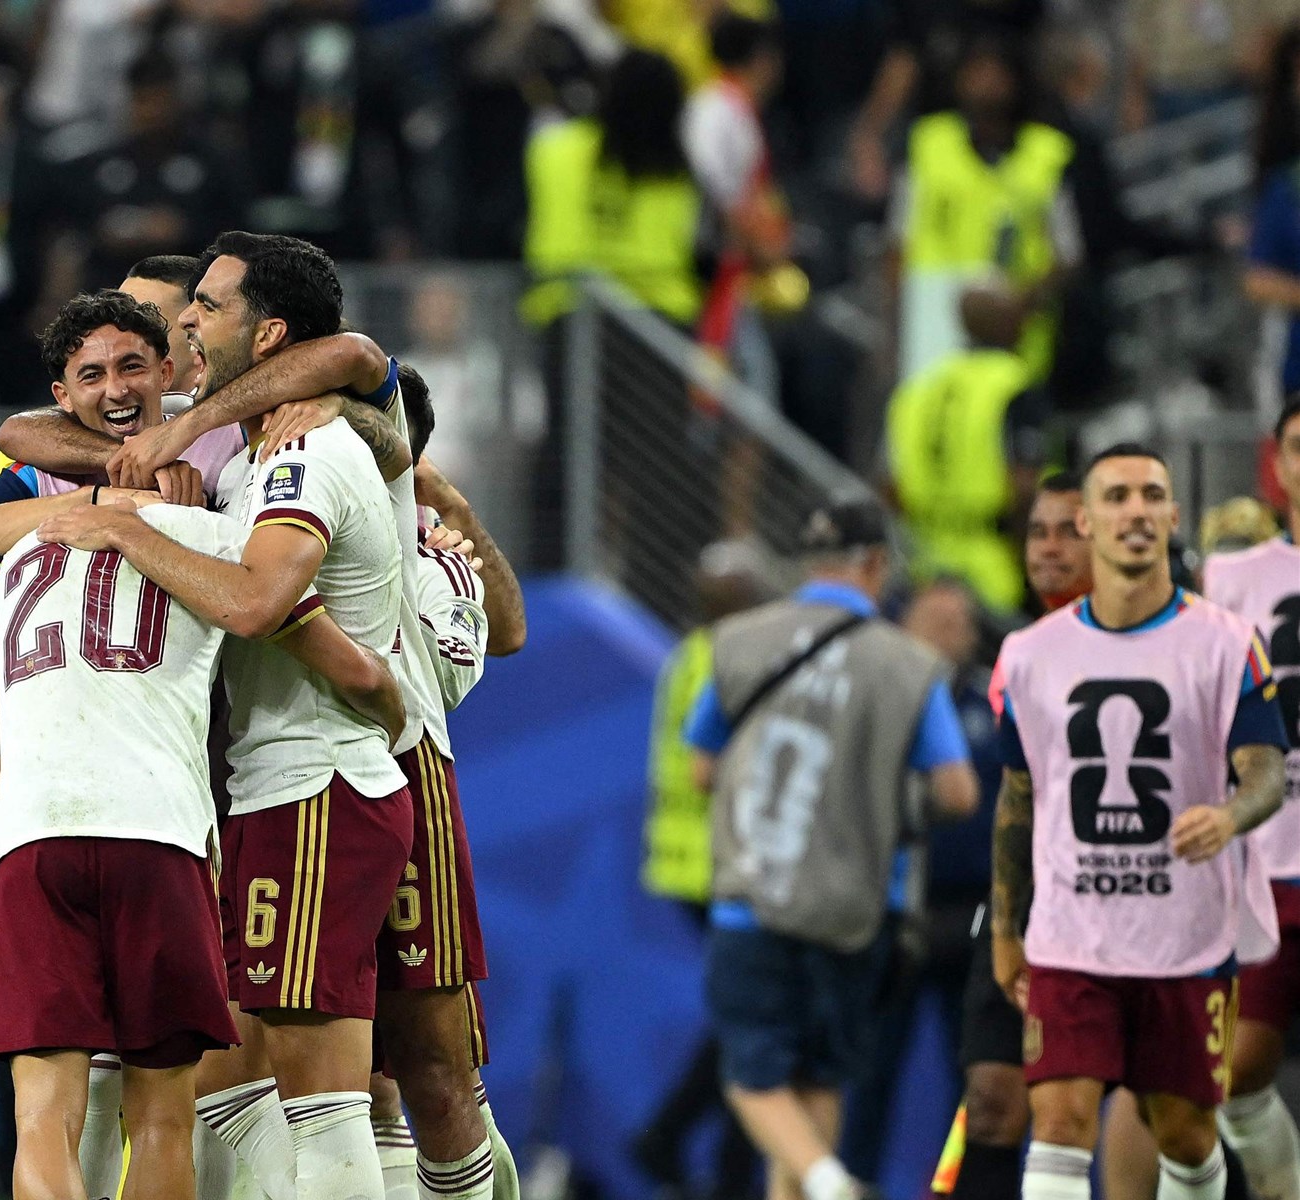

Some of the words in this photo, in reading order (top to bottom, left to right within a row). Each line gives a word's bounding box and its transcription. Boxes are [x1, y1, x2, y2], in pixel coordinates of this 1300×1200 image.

[4, 541, 171, 693] 20
[1095, 811, 1145, 834] FIFA
[1077, 854, 1132, 868] WORLD
[1135, 853, 1171, 868] CUP
[1074, 872, 1172, 896] 2026
[245, 877, 280, 948] 6
[1206, 991, 1225, 1055] 3
